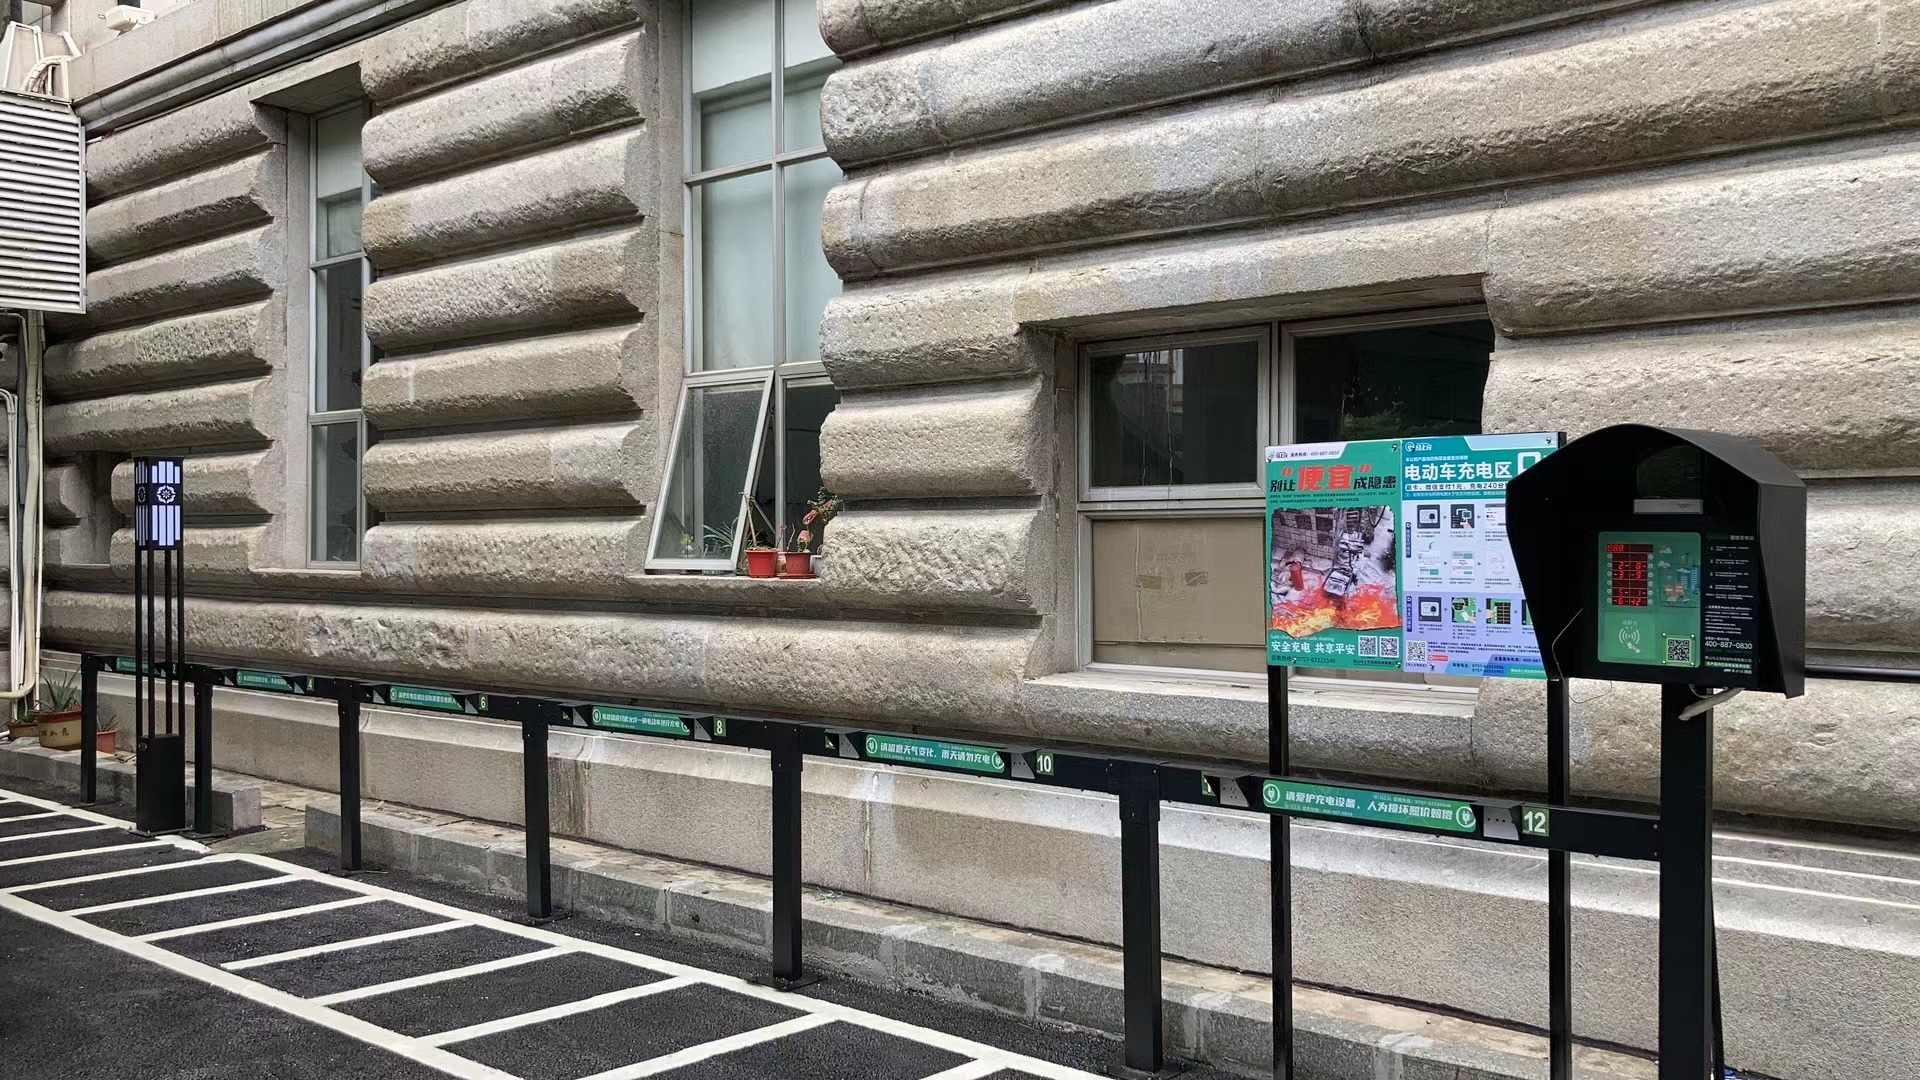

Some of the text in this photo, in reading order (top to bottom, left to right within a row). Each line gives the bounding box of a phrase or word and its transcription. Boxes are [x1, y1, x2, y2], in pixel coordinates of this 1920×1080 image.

[1404, 461, 1513, 481] 电动车充电区
[1406, 482, 1509, 491] 刷卡、微信支付1元，充电240分
[1271, 640, 1355, 655] 安全充电 共享平安
[1704, 640, 1753, 649] 400-887-0830
[480, 696, 486, 709] 6
[716, 720, 723, 734] 8
[1036, 754, 1052, 772] 10
[1285, 790, 1453, 820] 请爱护充电设备，人为损坏照价赔偿
[1523, 811, 1546, 834] 12
